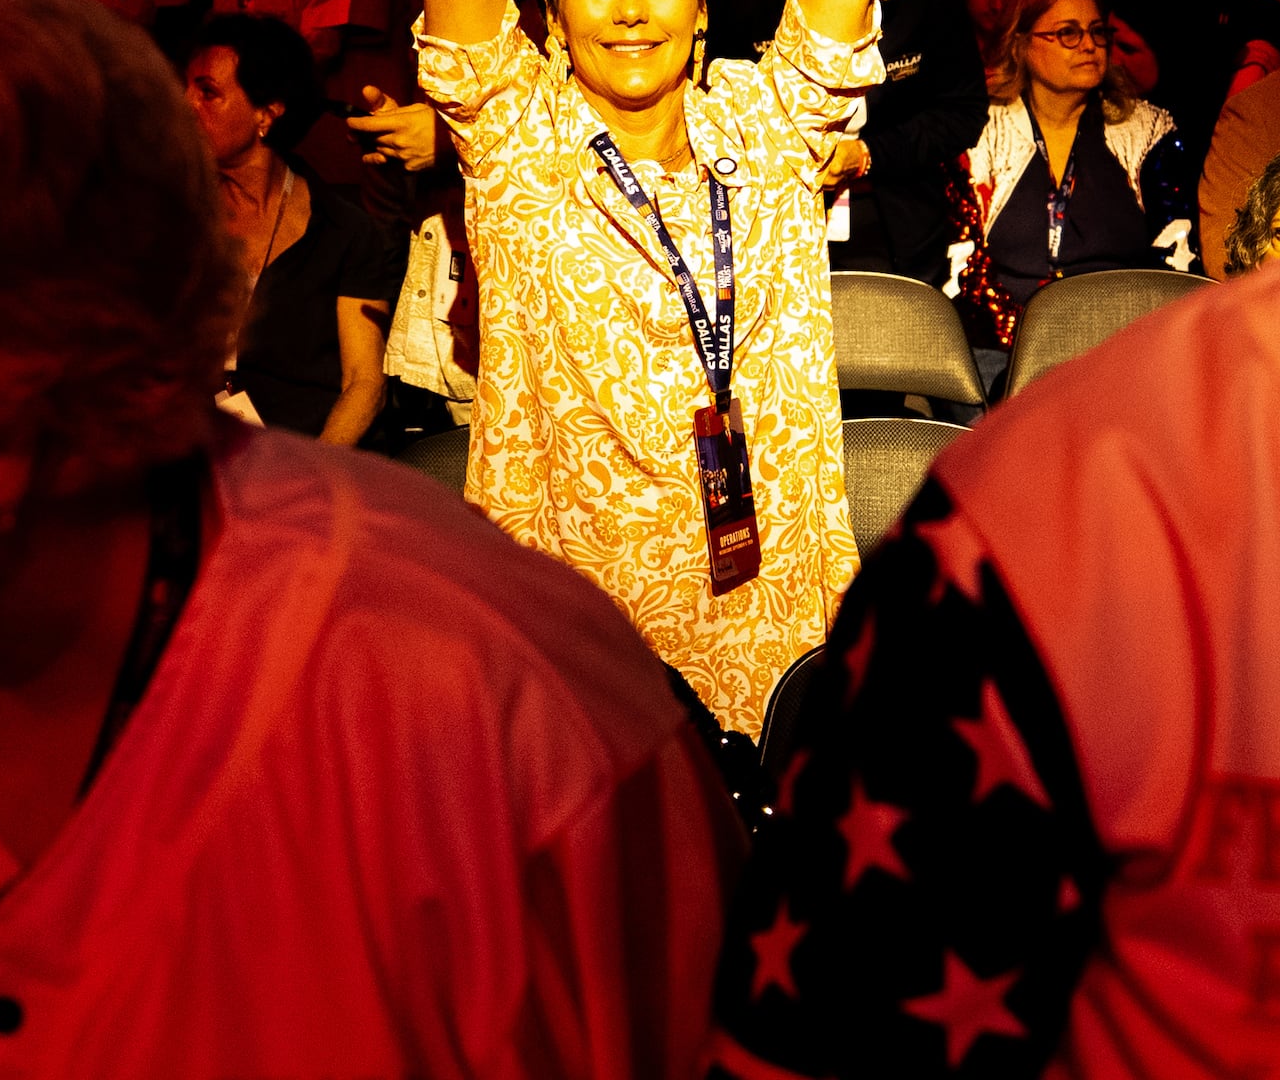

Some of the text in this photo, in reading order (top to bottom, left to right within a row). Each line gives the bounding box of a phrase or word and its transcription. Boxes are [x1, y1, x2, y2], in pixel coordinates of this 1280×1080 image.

[887, 53, 922, 72] DALLAS
[602, 148, 640, 195] DALLAS
[724, 264, 732, 288] TRUST
[682, 283, 700, 314] WinRed
[694, 318, 716, 371] DALLAS
[718, 314, 731, 370] DALLAS
[719, 526, 751, 548] OPERATIONS
